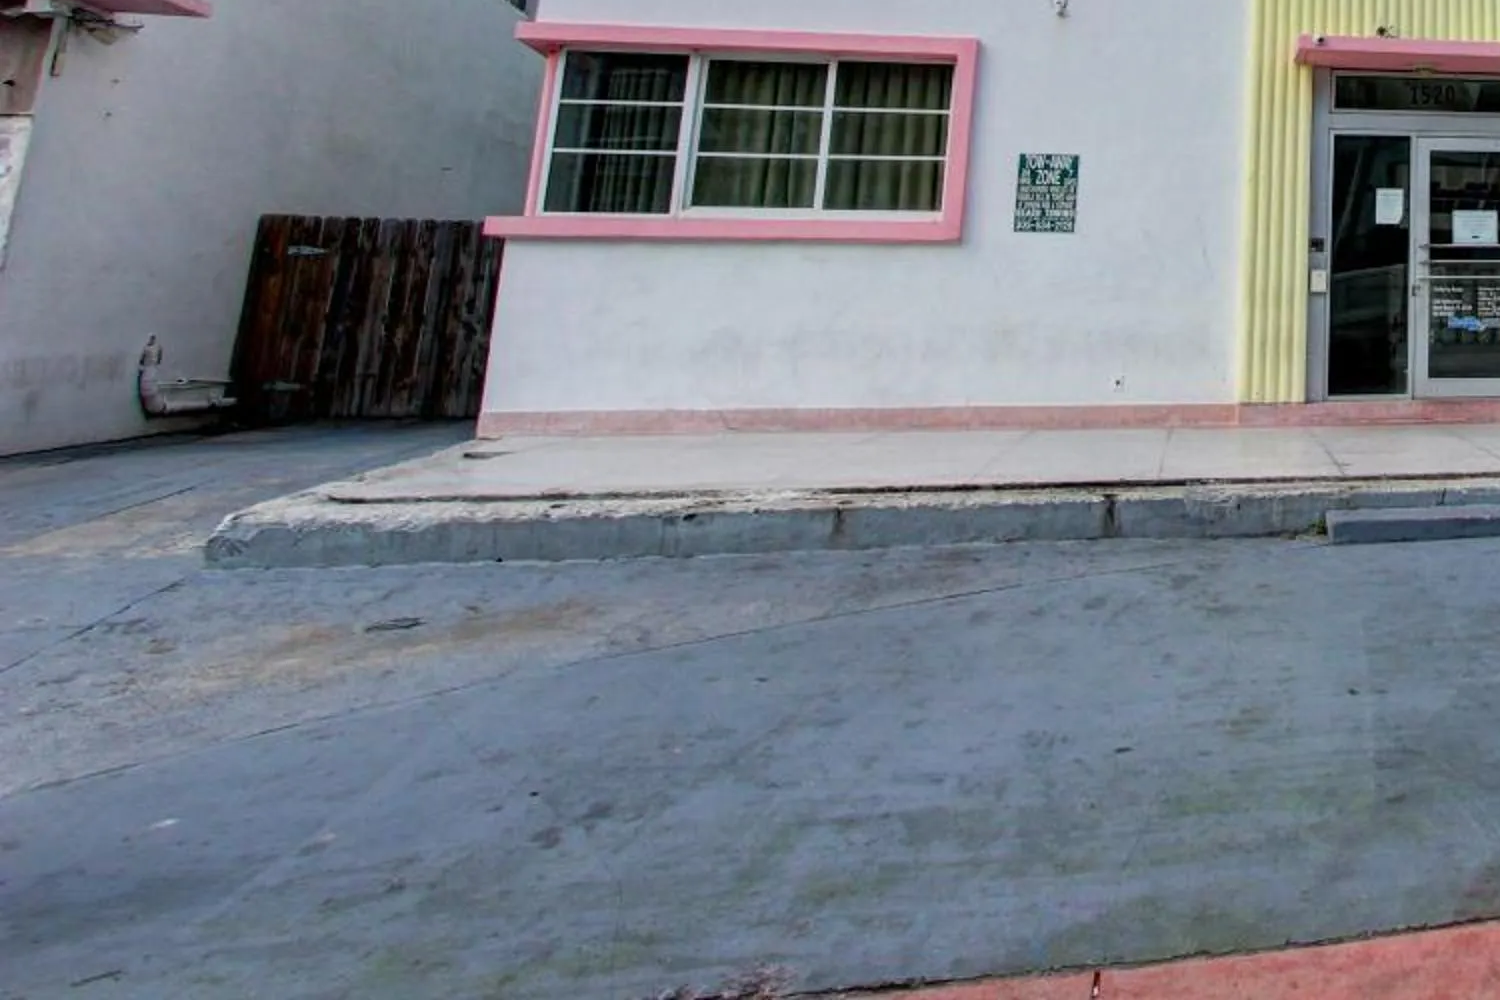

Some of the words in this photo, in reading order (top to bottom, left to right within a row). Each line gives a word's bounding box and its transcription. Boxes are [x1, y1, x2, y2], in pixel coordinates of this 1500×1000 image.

[1410, 84, 1456, 105] 1520
[1026, 154, 1072, 169] TOW-AWAY
[1035, 170, 1061, 185] ZONE
